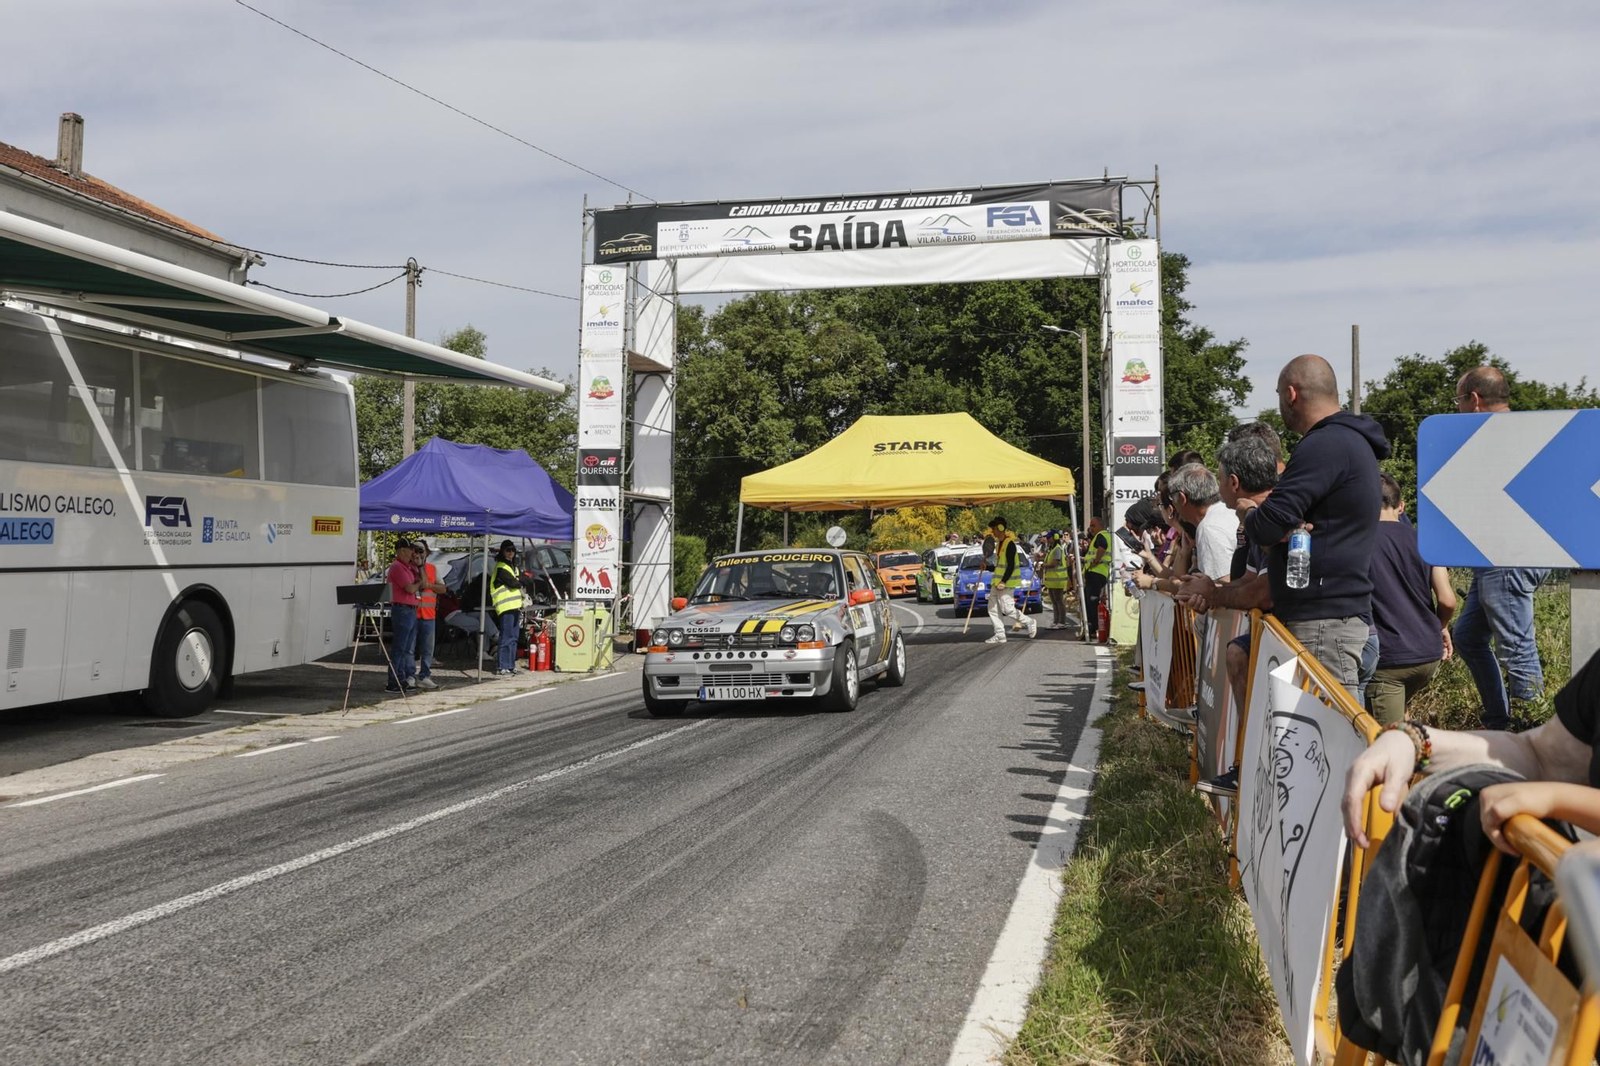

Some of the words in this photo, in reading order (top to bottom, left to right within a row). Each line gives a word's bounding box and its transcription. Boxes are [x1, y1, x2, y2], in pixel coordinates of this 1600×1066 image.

[729, 201, 819, 217] CAMPIONATO
[823, 199, 876, 212] GALEGO
[879, 198, 899, 209] DE
[900, 192, 973, 208] MONTAÑA
[987, 205, 1042, 227] FGA
[789, 215, 909, 251] SAÍDA
[917, 236, 940, 244] VILAR
[946, 234, 977, 243] BARRIO
[720, 246, 742, 254] VILAR
[747, 244, 776, 252] BARRIO
[873, 441, 943, 452] STARK
[1115, 456, 1159, 464] OURENSE
[580, 467, 618, 475] OURENSE
[988, 480, 1051, 490] www.ausavil.com
[0, 493, 50, 512] LISMO
[55, 495, 116, 517] GALEGO,
[579, 498, 616, 507] STARK
[145, 495, 192, 527] FGA
[215, 519, 238, 529] XUNTA
[315, 519, 342, 532] PIRELLI
[215, 531, 225, 541] DE
[225, 531, 251, 541] GALICIA
[714, 556, 760, 569] Talleres
[763, 554, 834, 563] COUCEIRO
[577, 586, 610, 594] Oterino
